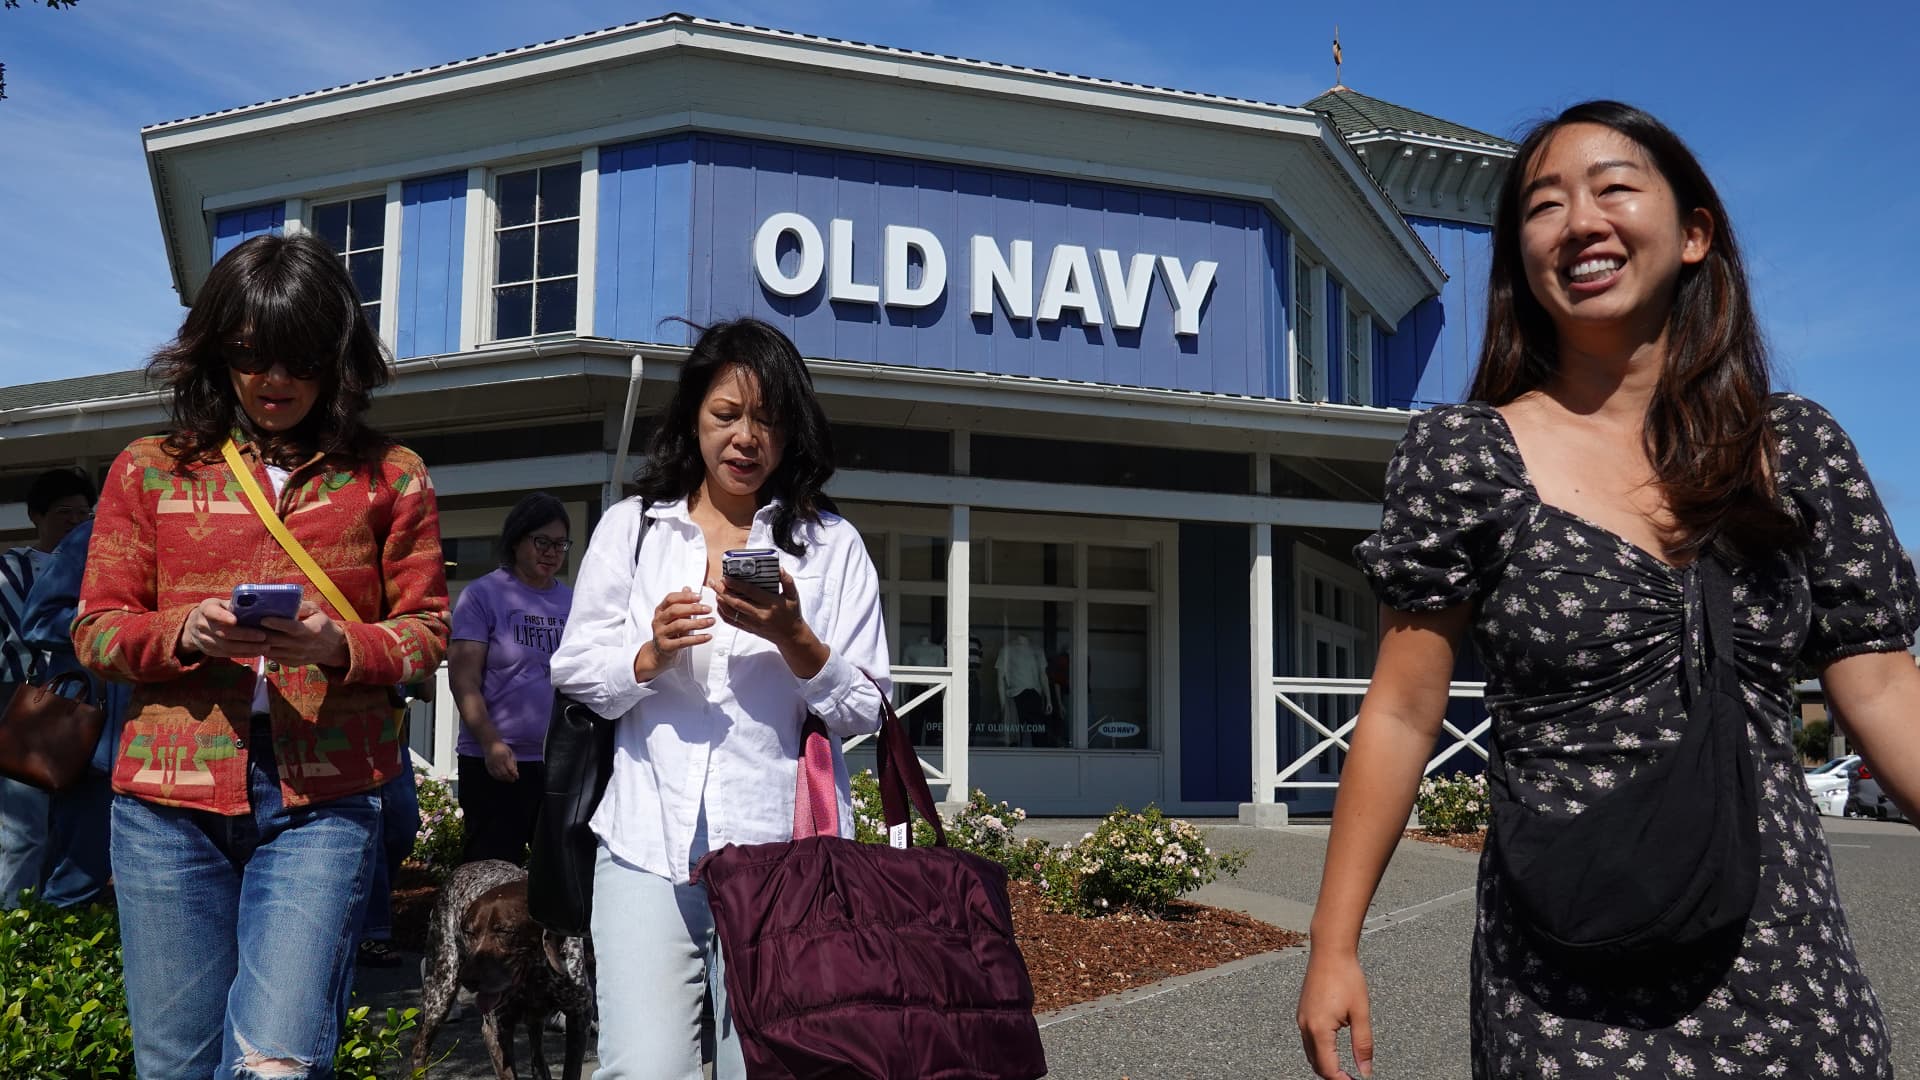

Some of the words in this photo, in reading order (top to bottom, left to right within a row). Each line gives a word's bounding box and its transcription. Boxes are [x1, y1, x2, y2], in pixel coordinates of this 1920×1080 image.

[753, 212, 947, 307] OLD
[970, 235, 1218, 336] NAVY
[524, 615, 545, 626] FIRST
[548, 617, 557, 626] OF
[514, 624, 563, 653] LIFETI
[926, 721, 943, 731] OPE
[975, 723, 984, 732] AT
[987, 723, 1045, 733] OLDNAVY.COM
